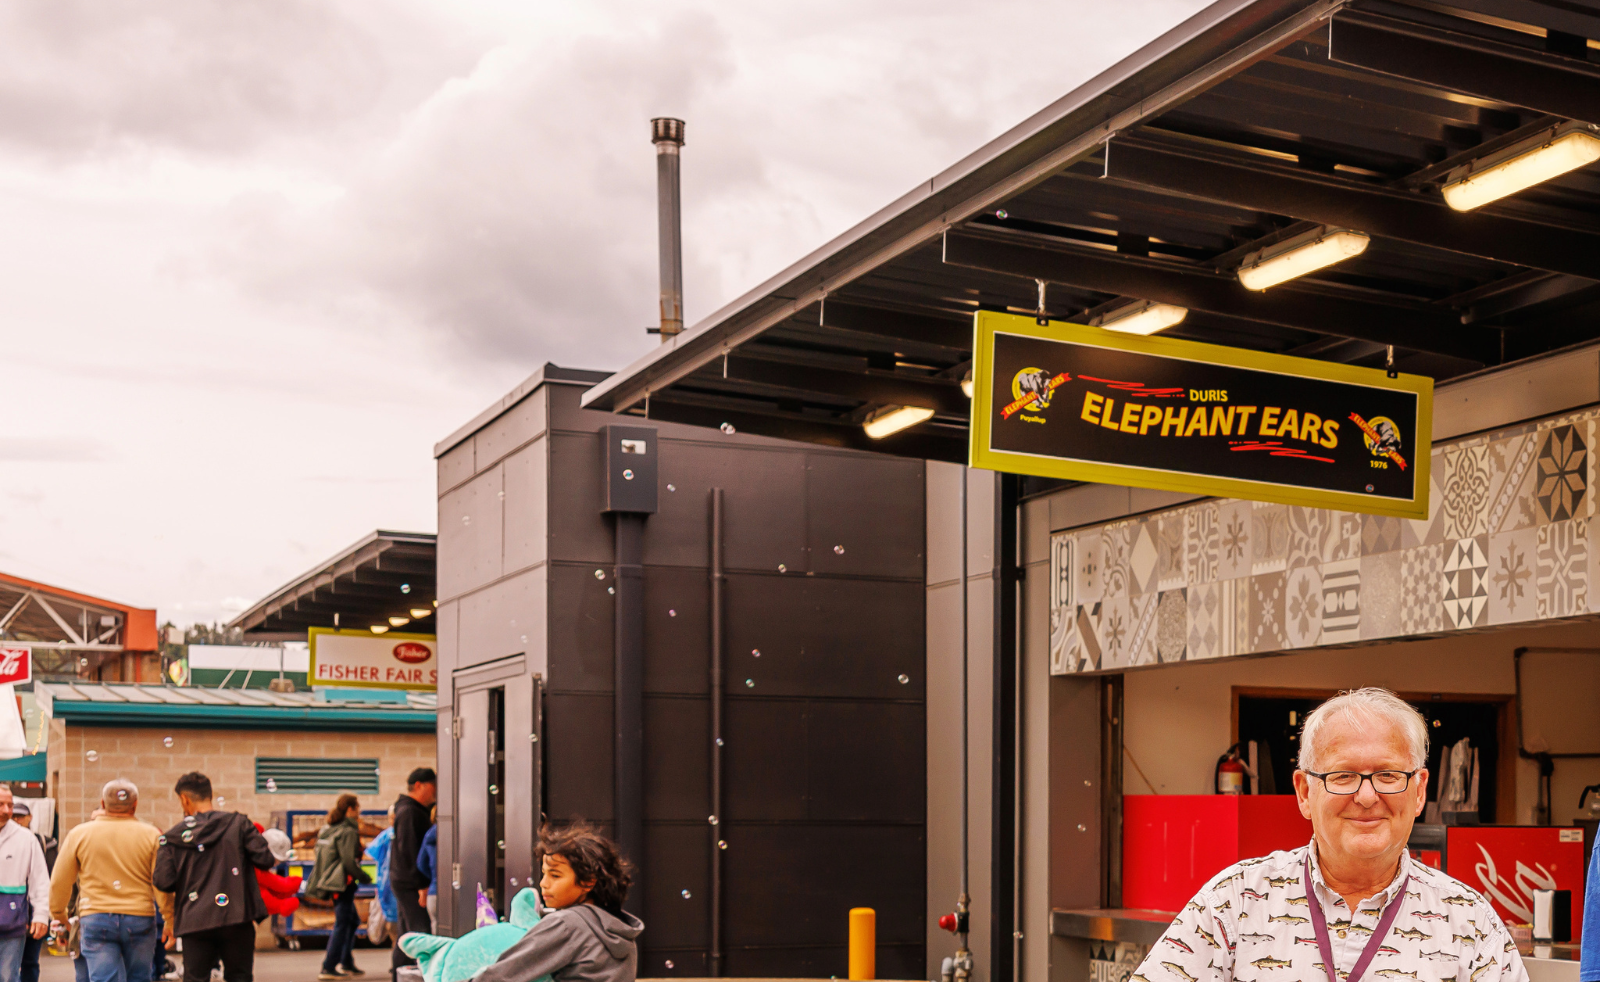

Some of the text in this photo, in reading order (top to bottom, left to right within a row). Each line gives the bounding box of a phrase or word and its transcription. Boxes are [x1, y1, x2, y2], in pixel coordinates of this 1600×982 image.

[1189, 389, 1229, 402] DURIS
[1080, 390, 1340, 449] ELEPHANT EARS
[1370, 460, 1388, 470] 1976
[319, 664, 437, 684] FISHER FAIR S
